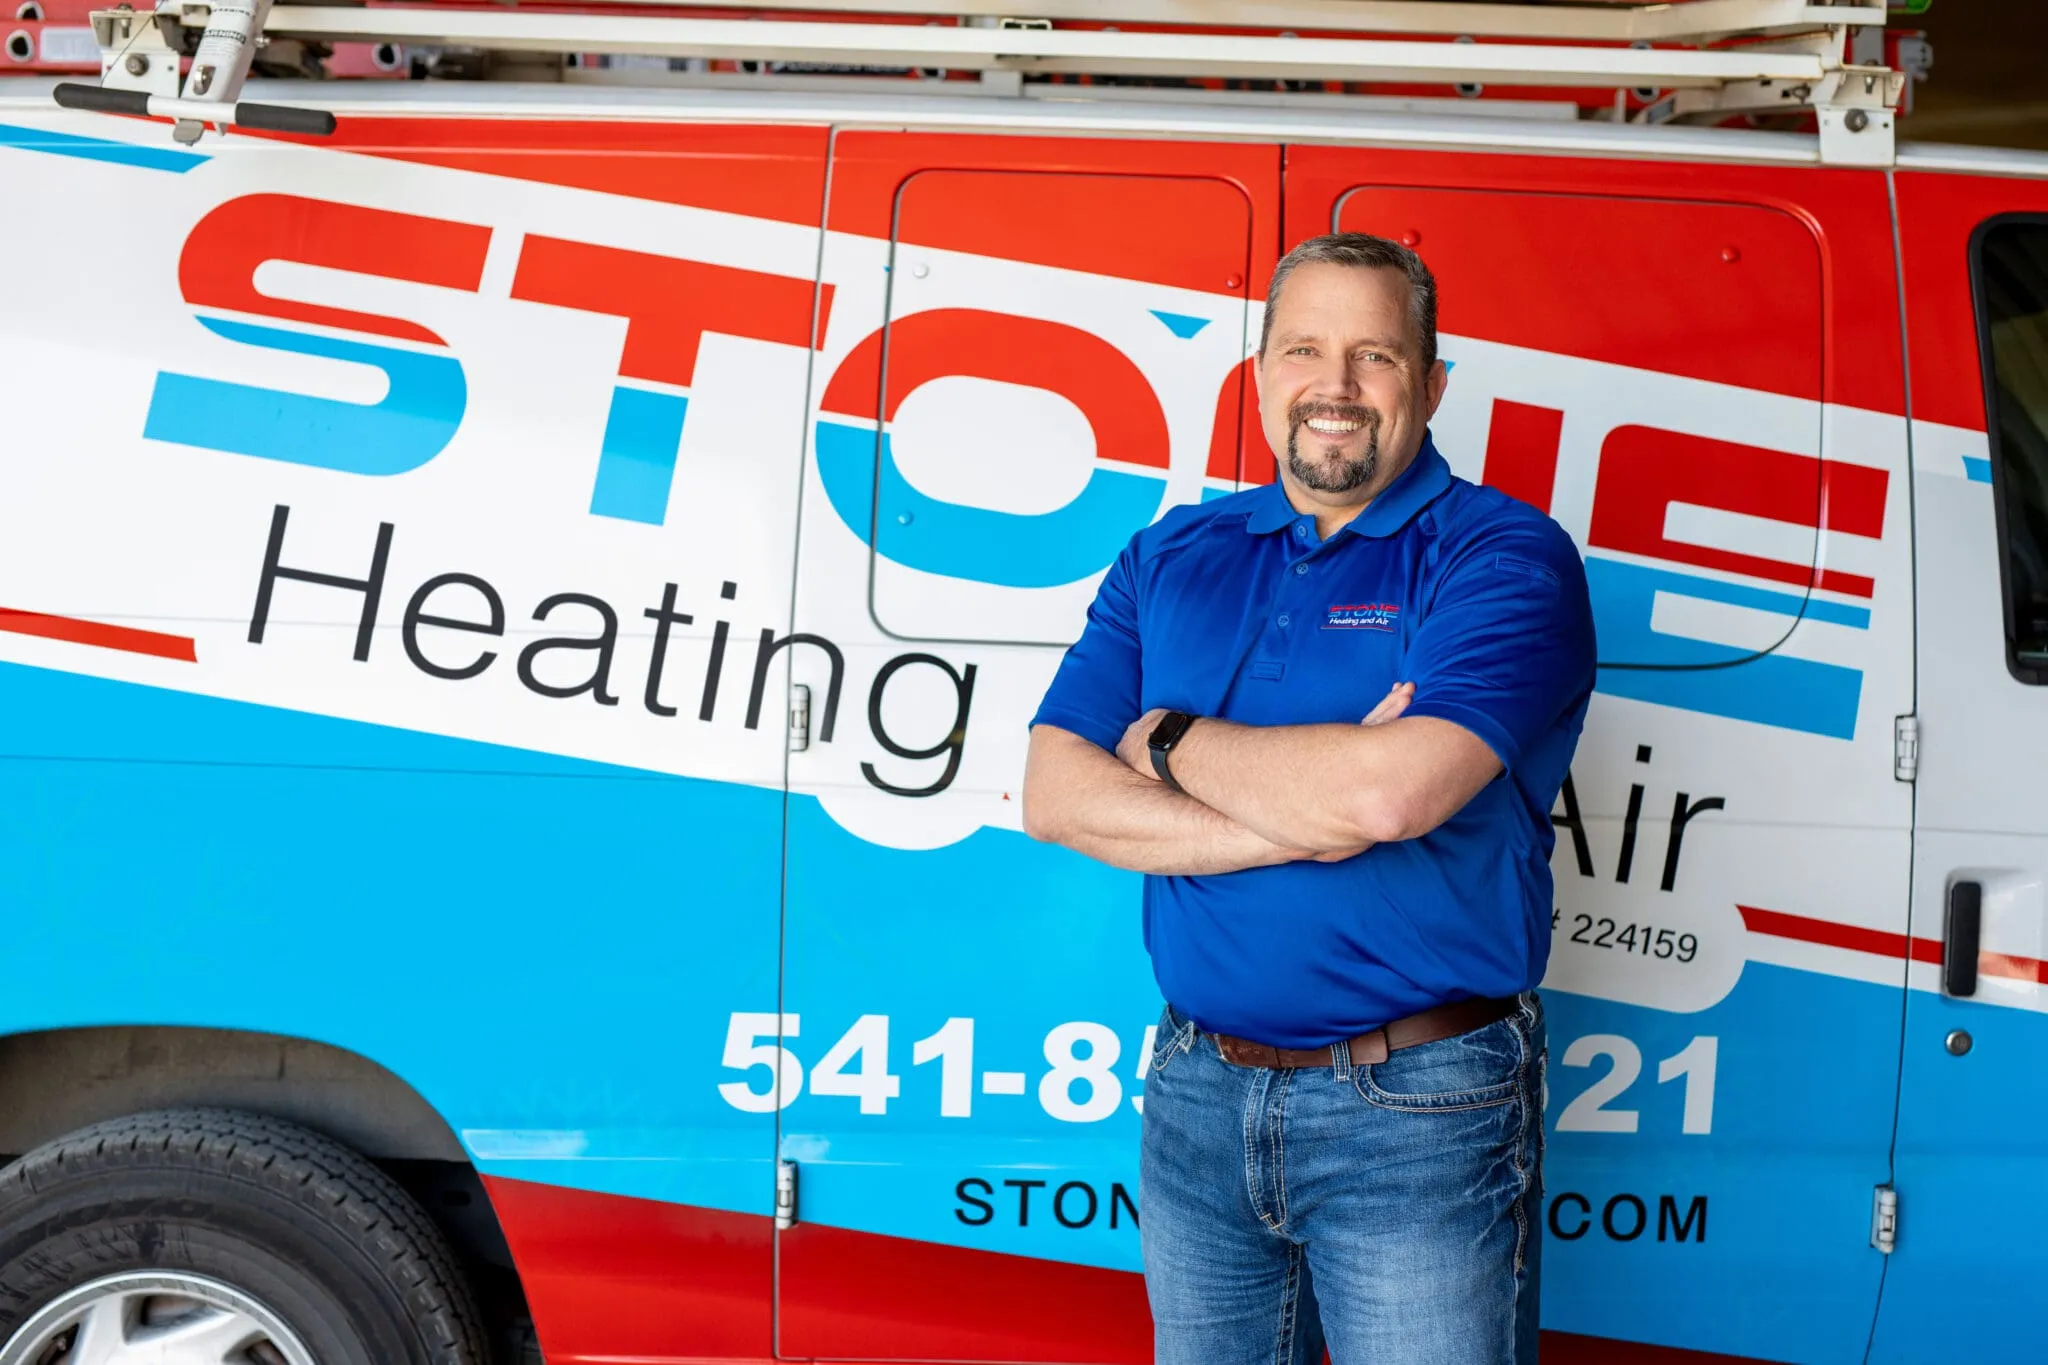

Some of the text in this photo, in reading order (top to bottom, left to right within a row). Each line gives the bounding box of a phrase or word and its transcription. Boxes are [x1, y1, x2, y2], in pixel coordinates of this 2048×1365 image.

[1328, 603, 1400, 619] STONE
[1329, 616, 1389, 627] Heating and Air
[247, 504, 977, 798] Heating
[1570, 913, 1698, 963] 224159
